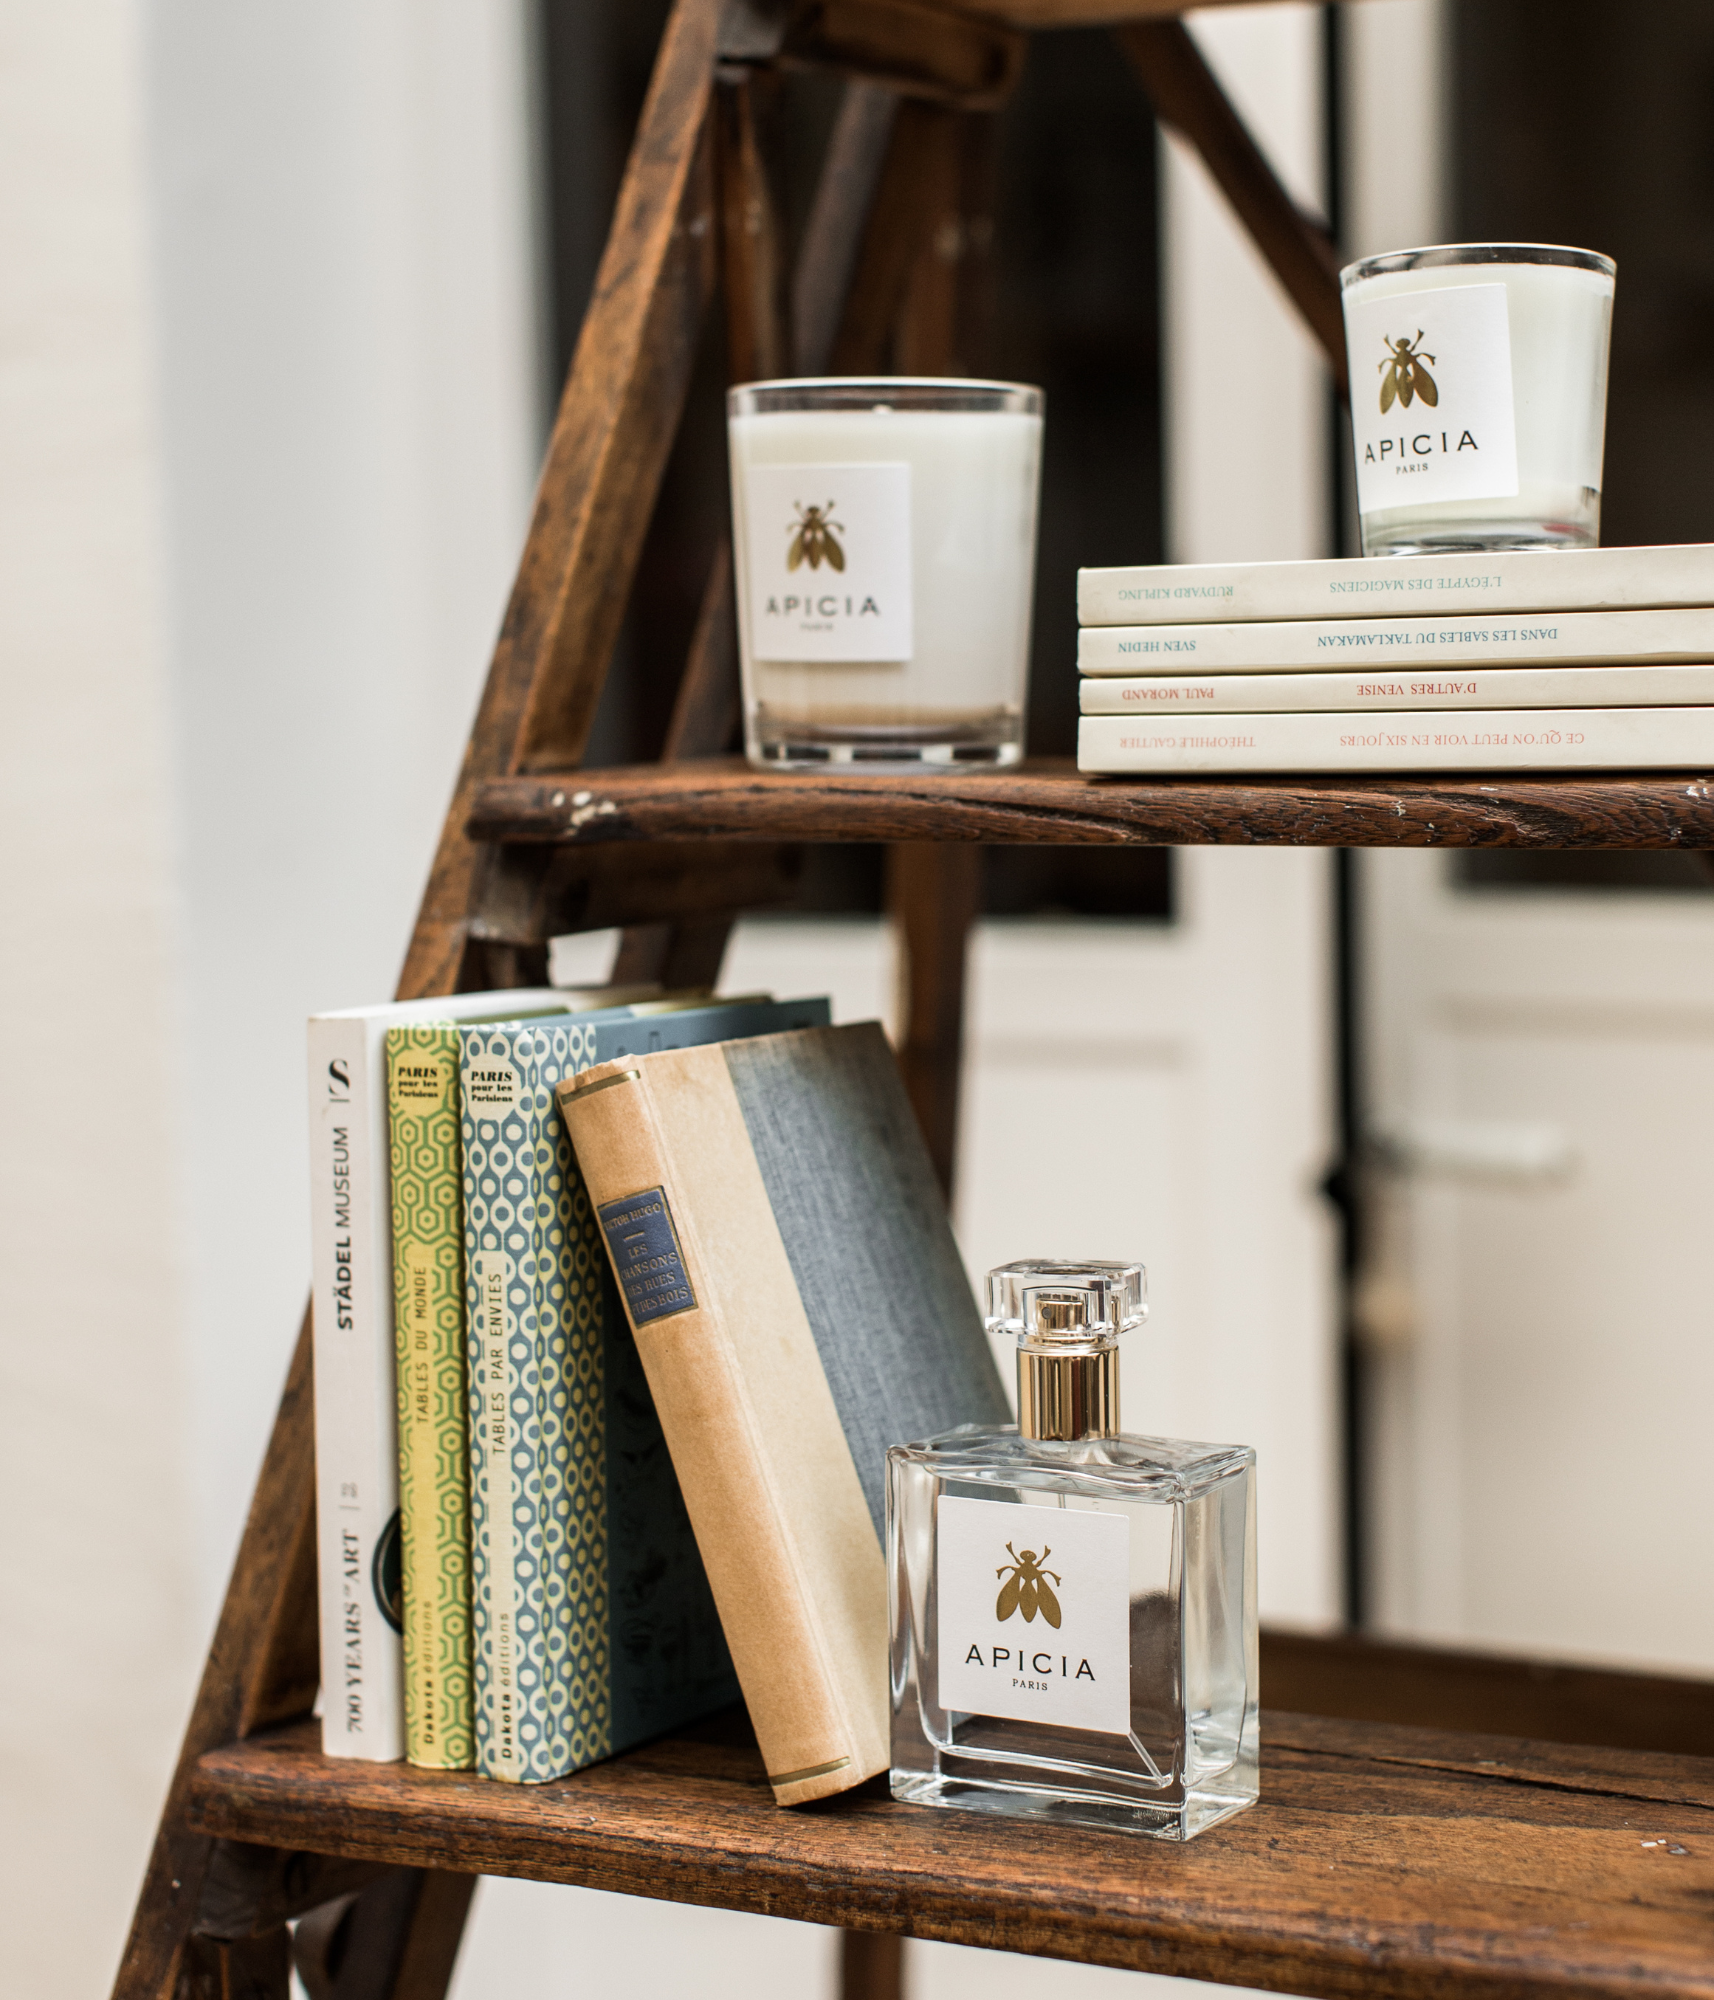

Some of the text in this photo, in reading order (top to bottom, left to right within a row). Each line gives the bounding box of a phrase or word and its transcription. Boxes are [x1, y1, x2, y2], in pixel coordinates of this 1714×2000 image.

[1365, 430, 1479, 464] APICIA
[1396, 463, 1429, 475] PARIS
[1118, 586, 1234, 600] RUDYARD KIPLING
[1329, 576, 1502, 593] L'ÉGYPTE DES MAGICIENS
[766, 596, 880, 617] APICIA
[1118, 640, 1196, 653] SVEN HEDIN
[1317, 628, 1558, 647] DANS LES SABLES DU TAKLAMAKAN
[1122, 687, 1214, 700] PAUL MORAND
[1356, 682, 1477, 696] D'AUTRES VENISE
[1120, 736, 1257, 750] THÉOPHILE GAUTIER
[1339, 729, 1585, 747] CE QU'ON PEUT VOIR EN SIX JOURS
[398, 1067, 438, 1078] PARIS
[471, 1071, 513, 1082] PARIS
[398, 1079, 438, 1088] pour les
[471, 1084, 513, 1094] pour les
[398, 1090, 438, 1098] Parisiens
[471, 1095, 513, 1103] Parisiens
[631, 1202, 662, 1221] HUGO
[332, 1127, 353, 1331] STÄDEL MUSEUM
[629, 1243, 649, 1258] LES
[645, 1271, 676, 1291] RUES
[659, 1286, 689, 1305] BOIS
[413, 1266, 430, 1423] TABLES DU MONDE
[488, 1273, 505, 1455] TABLES PAR ENVIES
[341, 1529, 361, 1584] ART
[343, 1602, 363, 1689] YEARS
[965, 1644, 1096, 1682] APICIA
[421, 1601, 435, 1745] Dakota éditions
[498, 1612, 513, 1759] Dakota éditions
[1012, 1678, 1048, 1691] PARIS
[345, 1694, 364, 1733] 700
